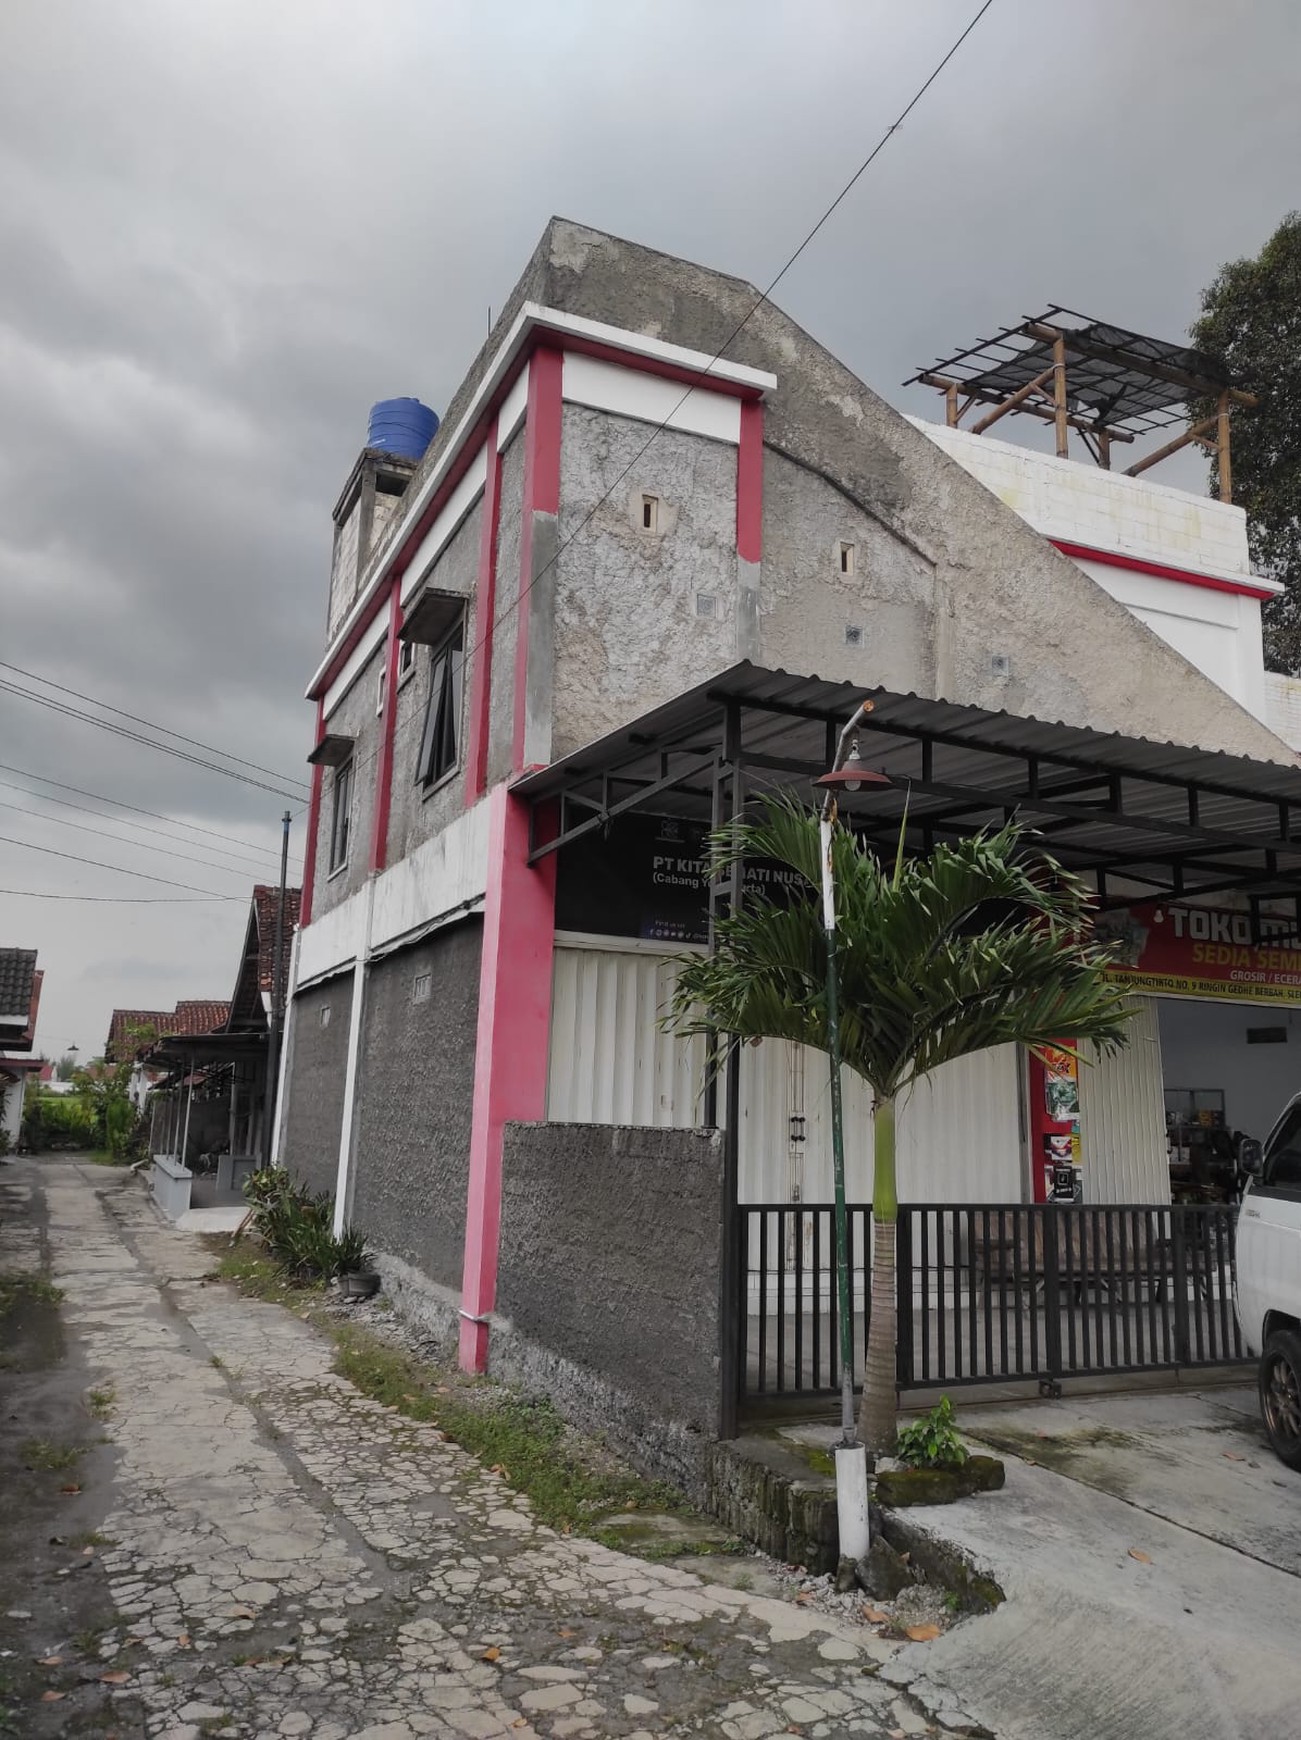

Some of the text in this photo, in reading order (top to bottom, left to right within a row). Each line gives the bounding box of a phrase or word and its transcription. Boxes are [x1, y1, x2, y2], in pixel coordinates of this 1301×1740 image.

[653, 856, 674, 871] PT
[653, 872, 699, 888] (Cabang
[1167, 907, 1251, 945] TOKO
[1192, 943, 1250, 967] SEDIA
[1230, 969, 1266, 983] GROSIR
